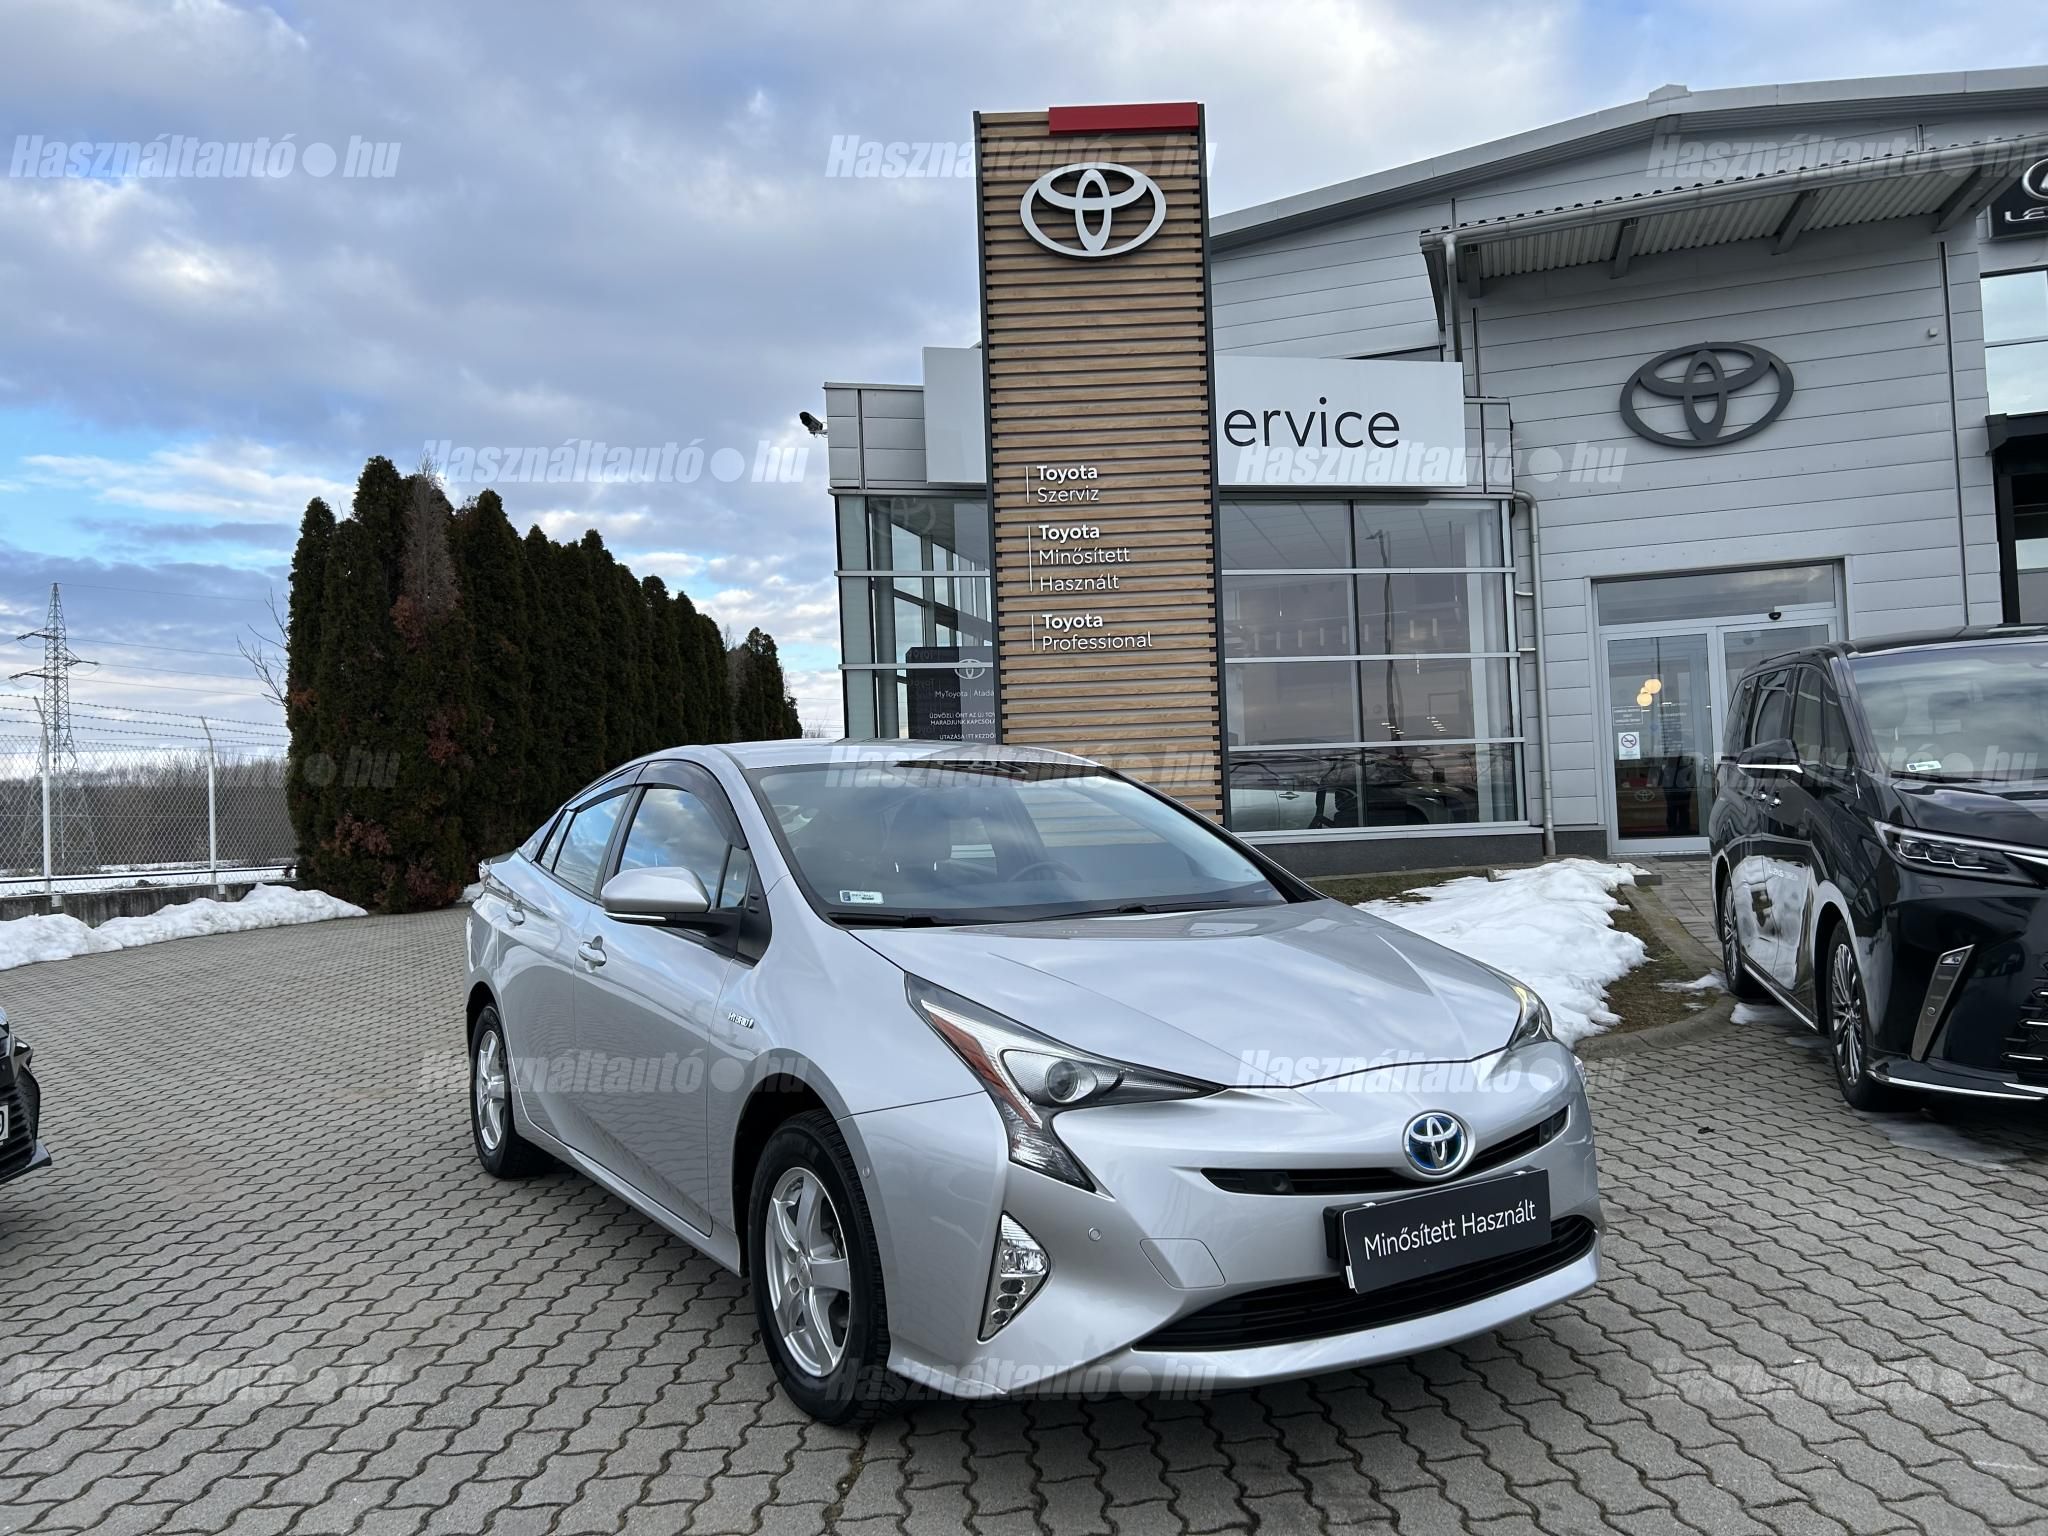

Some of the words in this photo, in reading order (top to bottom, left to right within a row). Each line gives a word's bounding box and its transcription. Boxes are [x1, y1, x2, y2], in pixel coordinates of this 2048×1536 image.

[1223, 396, 1400, 449] ervice
[1037, 465, 1098, 484] Toyota
[1037, 486, 1099, 503] Szerviz
[1039, 524, 1100, 544] Toyota
[1039, 547, 1130, 565] Minősített
[1040, 573, 1120, 592] Használt
[1042, 613, 1104, 633] Toyota
[1042, 632, 1153, 651] Professional
[1364, 1219, 1457, 1261] Minősített
[1461, 1199, 1537, 1237] Használt
